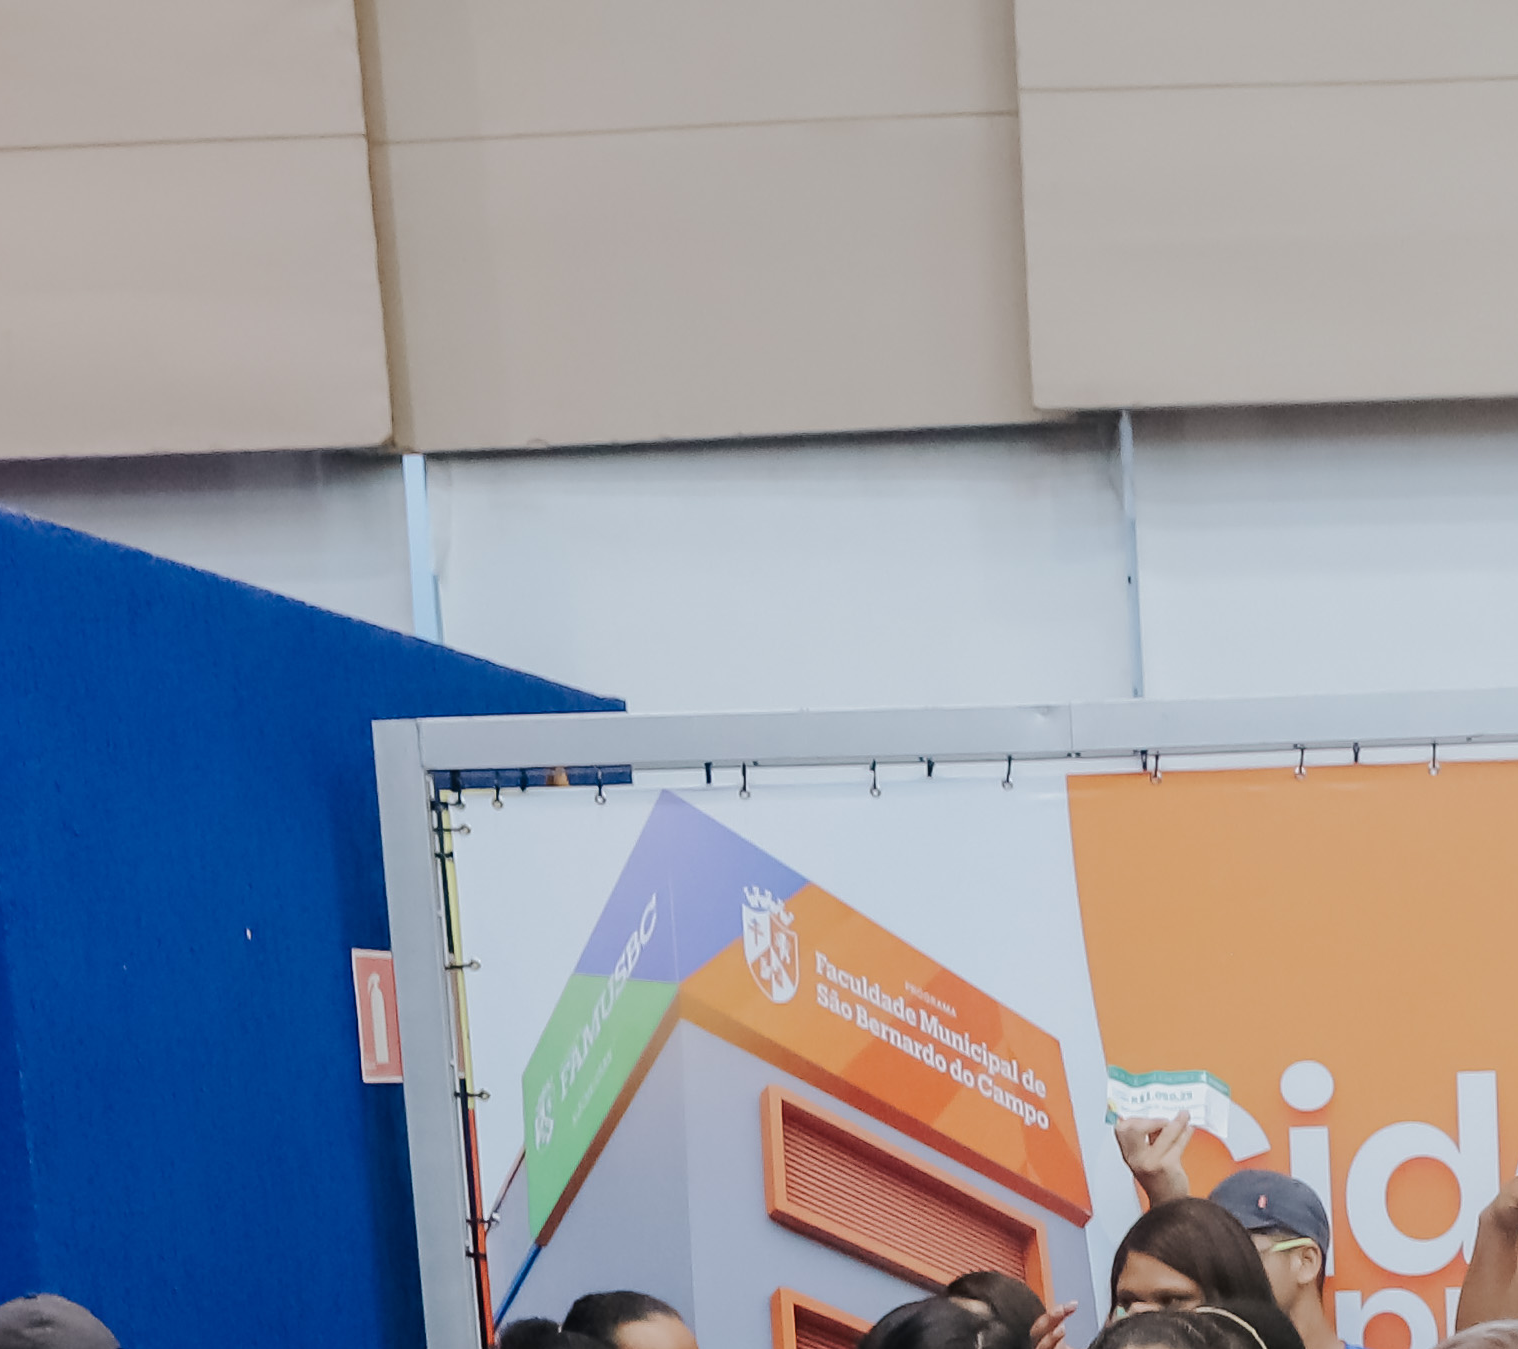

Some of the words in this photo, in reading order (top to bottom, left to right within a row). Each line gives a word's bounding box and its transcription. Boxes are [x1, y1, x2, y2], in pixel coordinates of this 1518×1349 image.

[815, 950, 917, 1026] Faculdade
[918, 1008, 1018, 1084] Municipal
[1022, 1067, 1046, 1098] de
[816, 983, 853, 1021] São
[856, 1004, 947, 1072] Bernardo
[950, 1058, 975, 1089] do
[977, 1074, 1050, 1130] Campo
